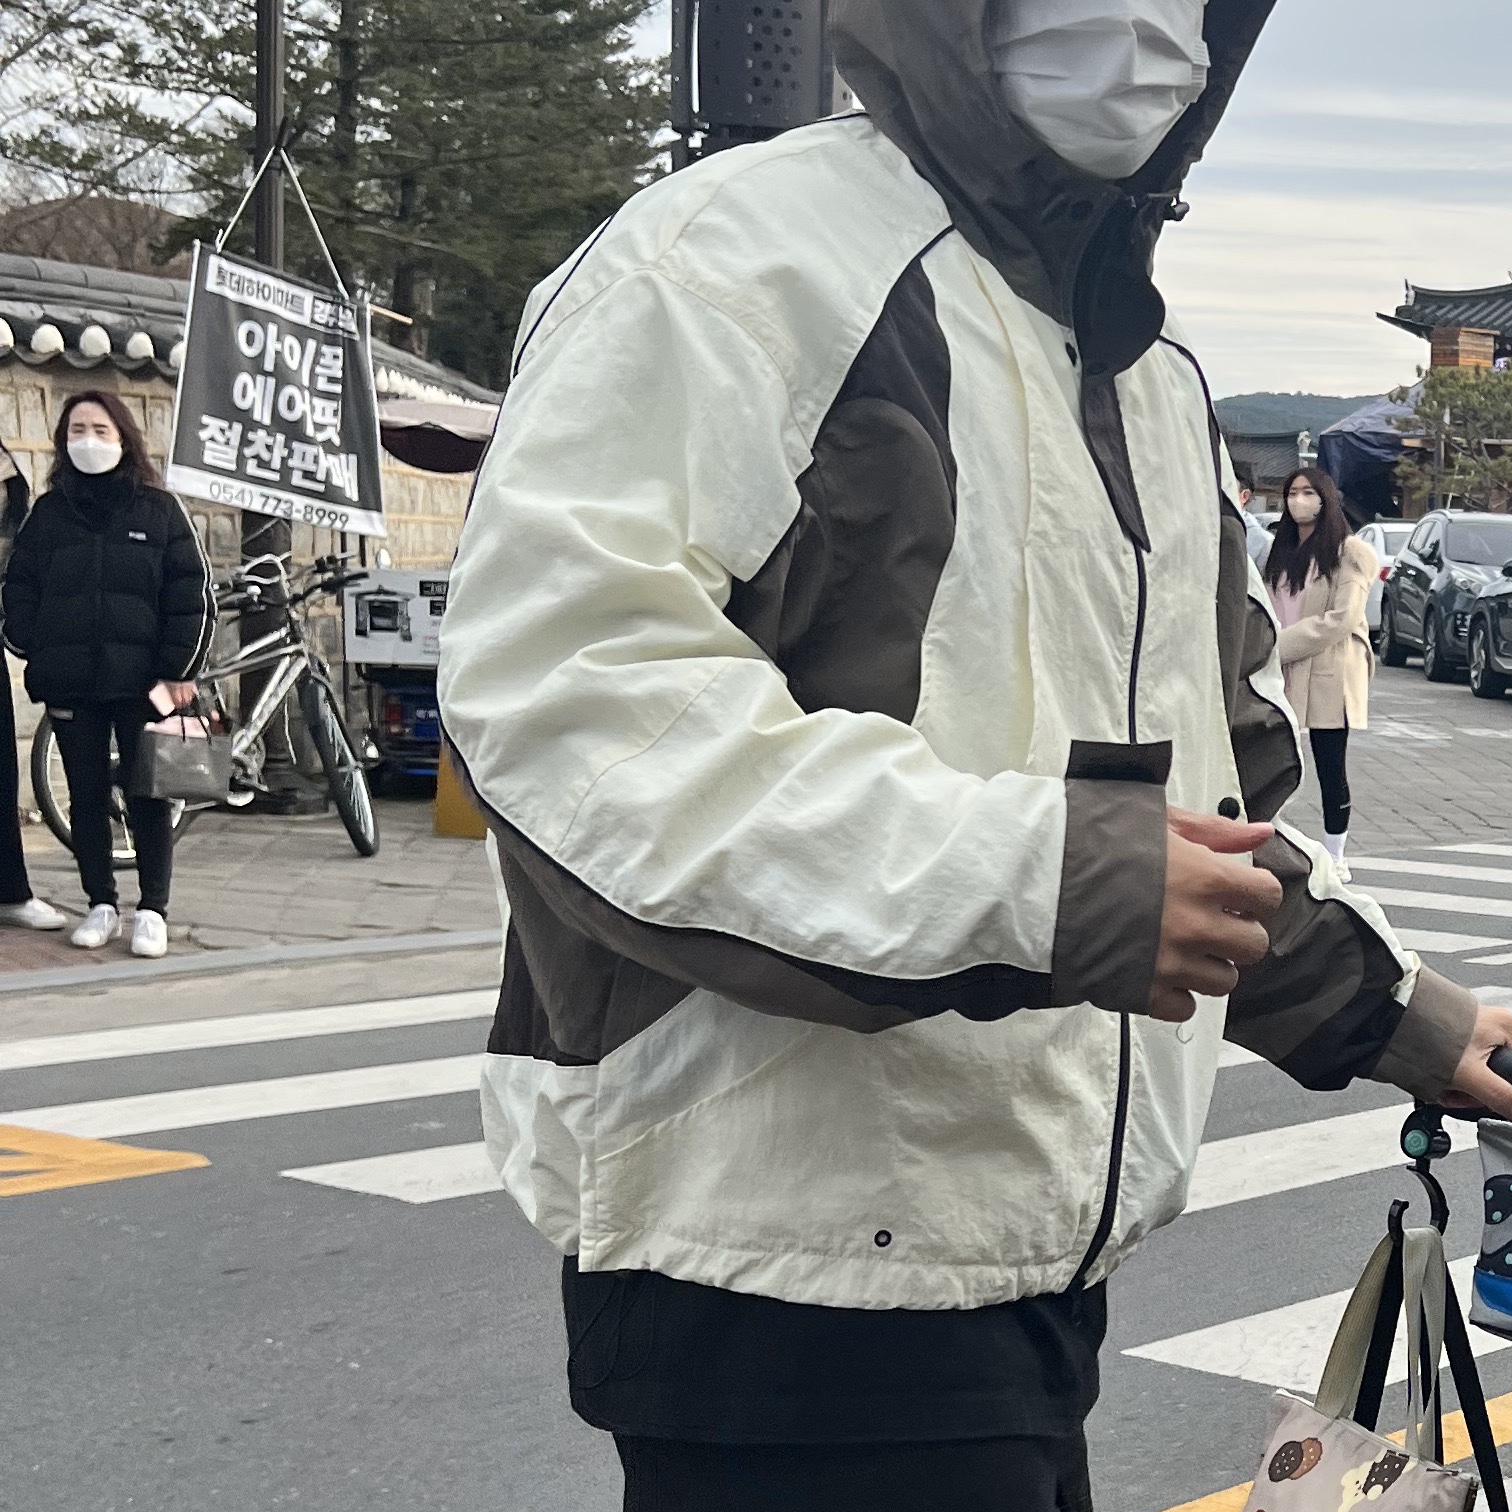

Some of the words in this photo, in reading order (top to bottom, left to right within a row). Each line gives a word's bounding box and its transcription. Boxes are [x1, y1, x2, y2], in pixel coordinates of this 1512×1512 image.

[237, 320, 343, 394] 아이폰
[198, 414, 359, 502] 절찬판매
[259, 490, 349, 529] 773-8999
